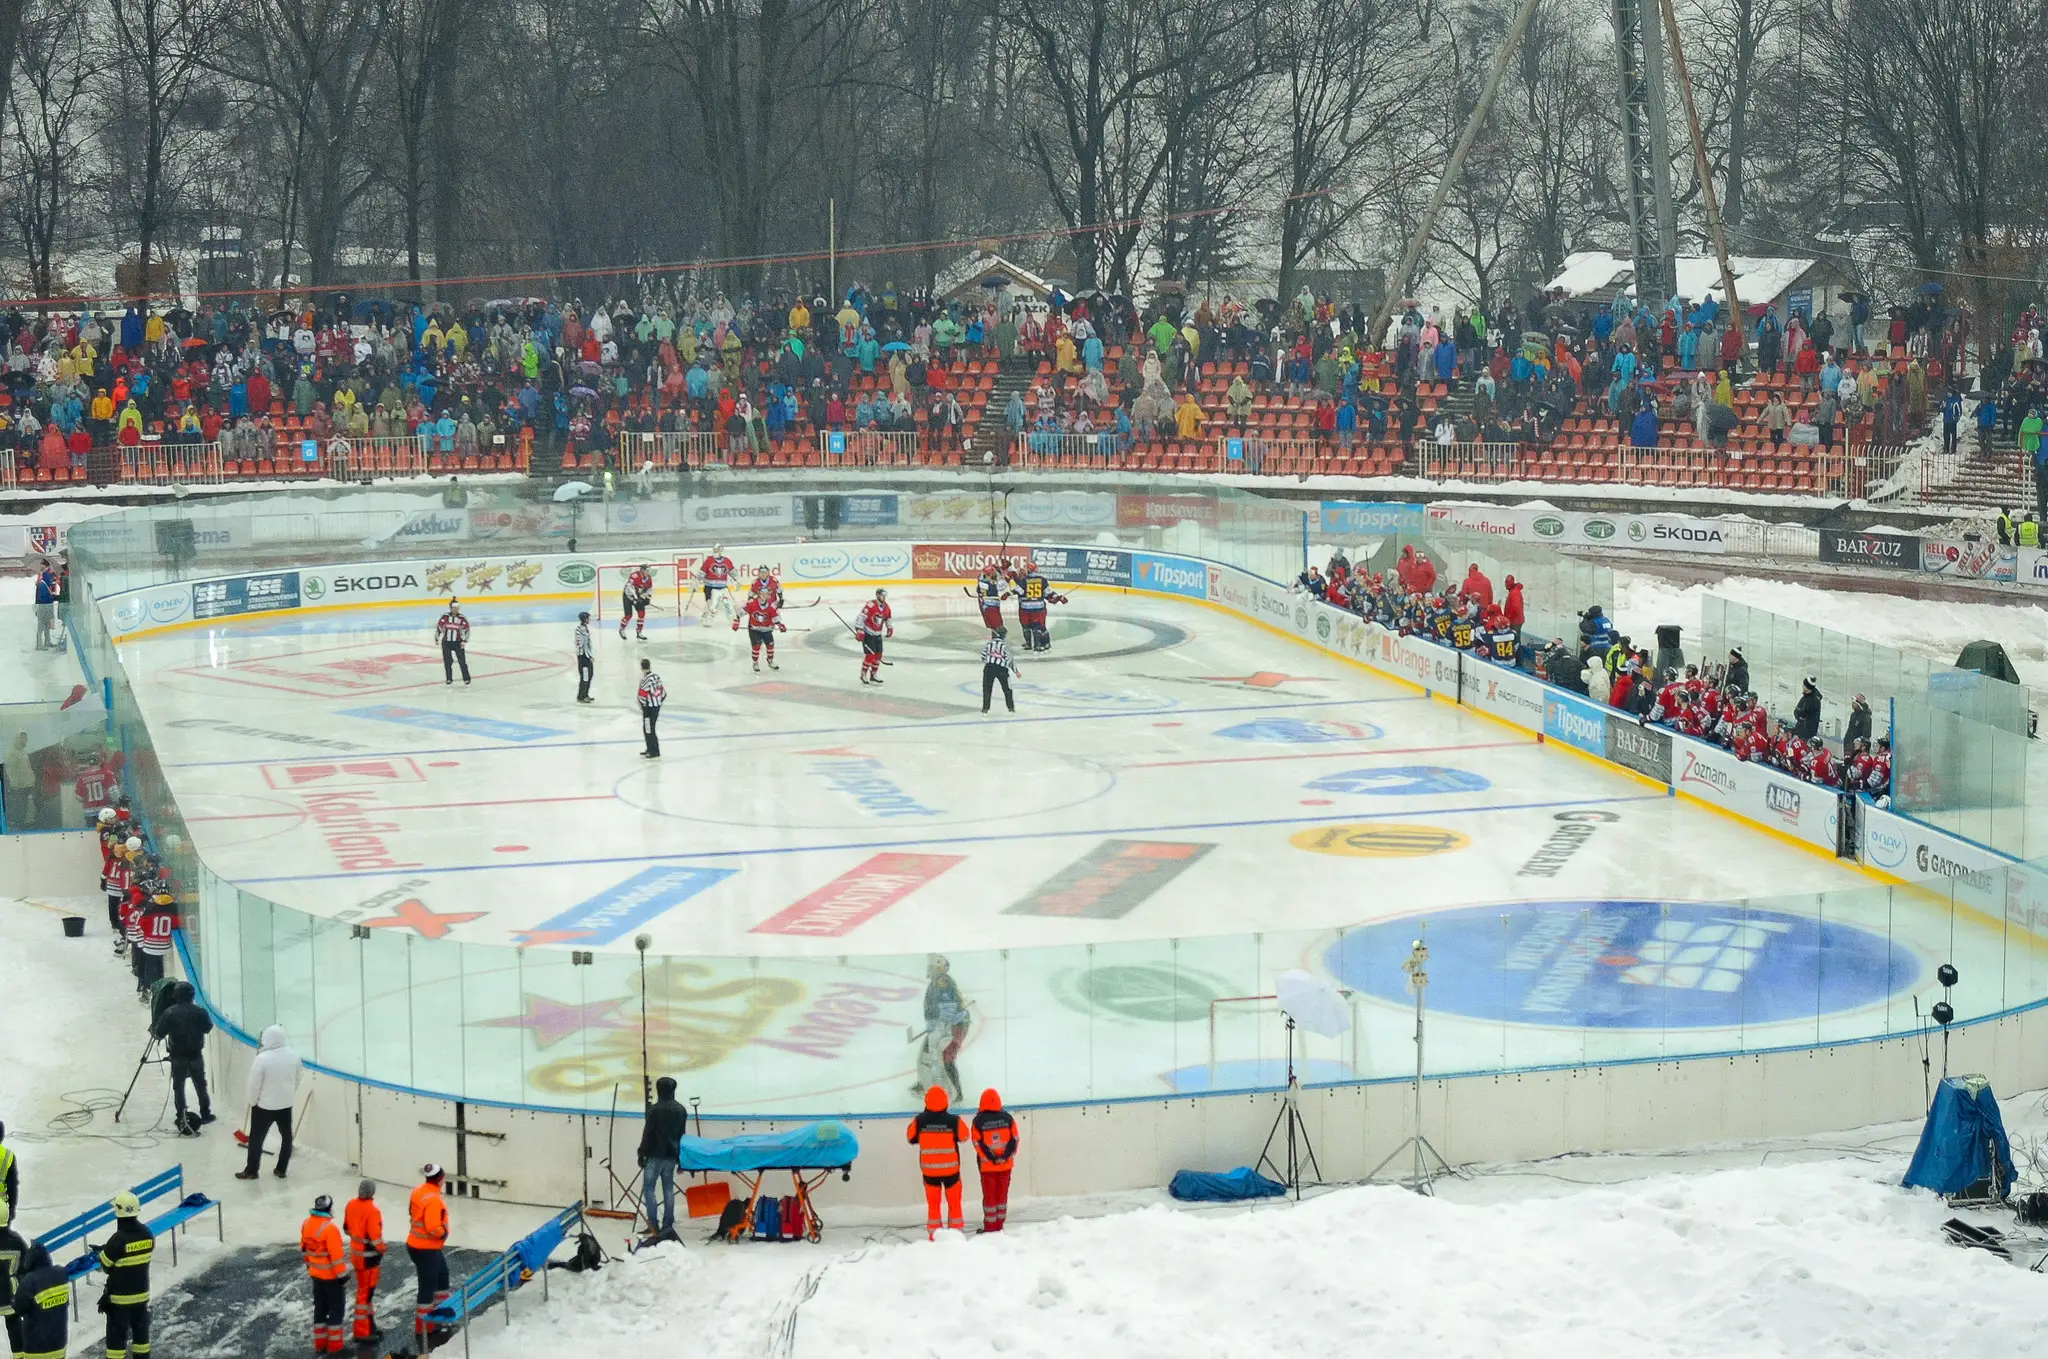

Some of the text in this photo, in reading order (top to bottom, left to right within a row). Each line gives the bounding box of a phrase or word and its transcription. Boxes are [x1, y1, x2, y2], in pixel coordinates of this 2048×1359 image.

[712, 506, 781, 519] GATORADE
[1455, 519, 1516, 535] Kaufland
[1653, 524, 1723, 543] ŠKODA
[1926, 543, 1945, 555] HELL
[1971, 553, 1989, 574] HELL
[334, 574, 419, 593] ŠKODA
[1152, 562, 1204, 591] Tipsport
[1026, 583, 1042, 599] 55
[1223, 585, 1249, 608] Kaufland
[1261, 594, 1291, 620] ŠKODA
[1453, 631, 1472, 647] 39
[1392, 639, 1431, 680] Orange
[1444, 666, 1481, 694] GATRADE
[1557, 703, 1601, 742] Tipsport
[85, 783, 104, 802] 10
[301, 790, 424, 871] Kaufland
[1516, 823, 1597, 878] GATORADE
[1931, 854, 1994, 895] GATORADE
[152, 916, 172, 937] 10
